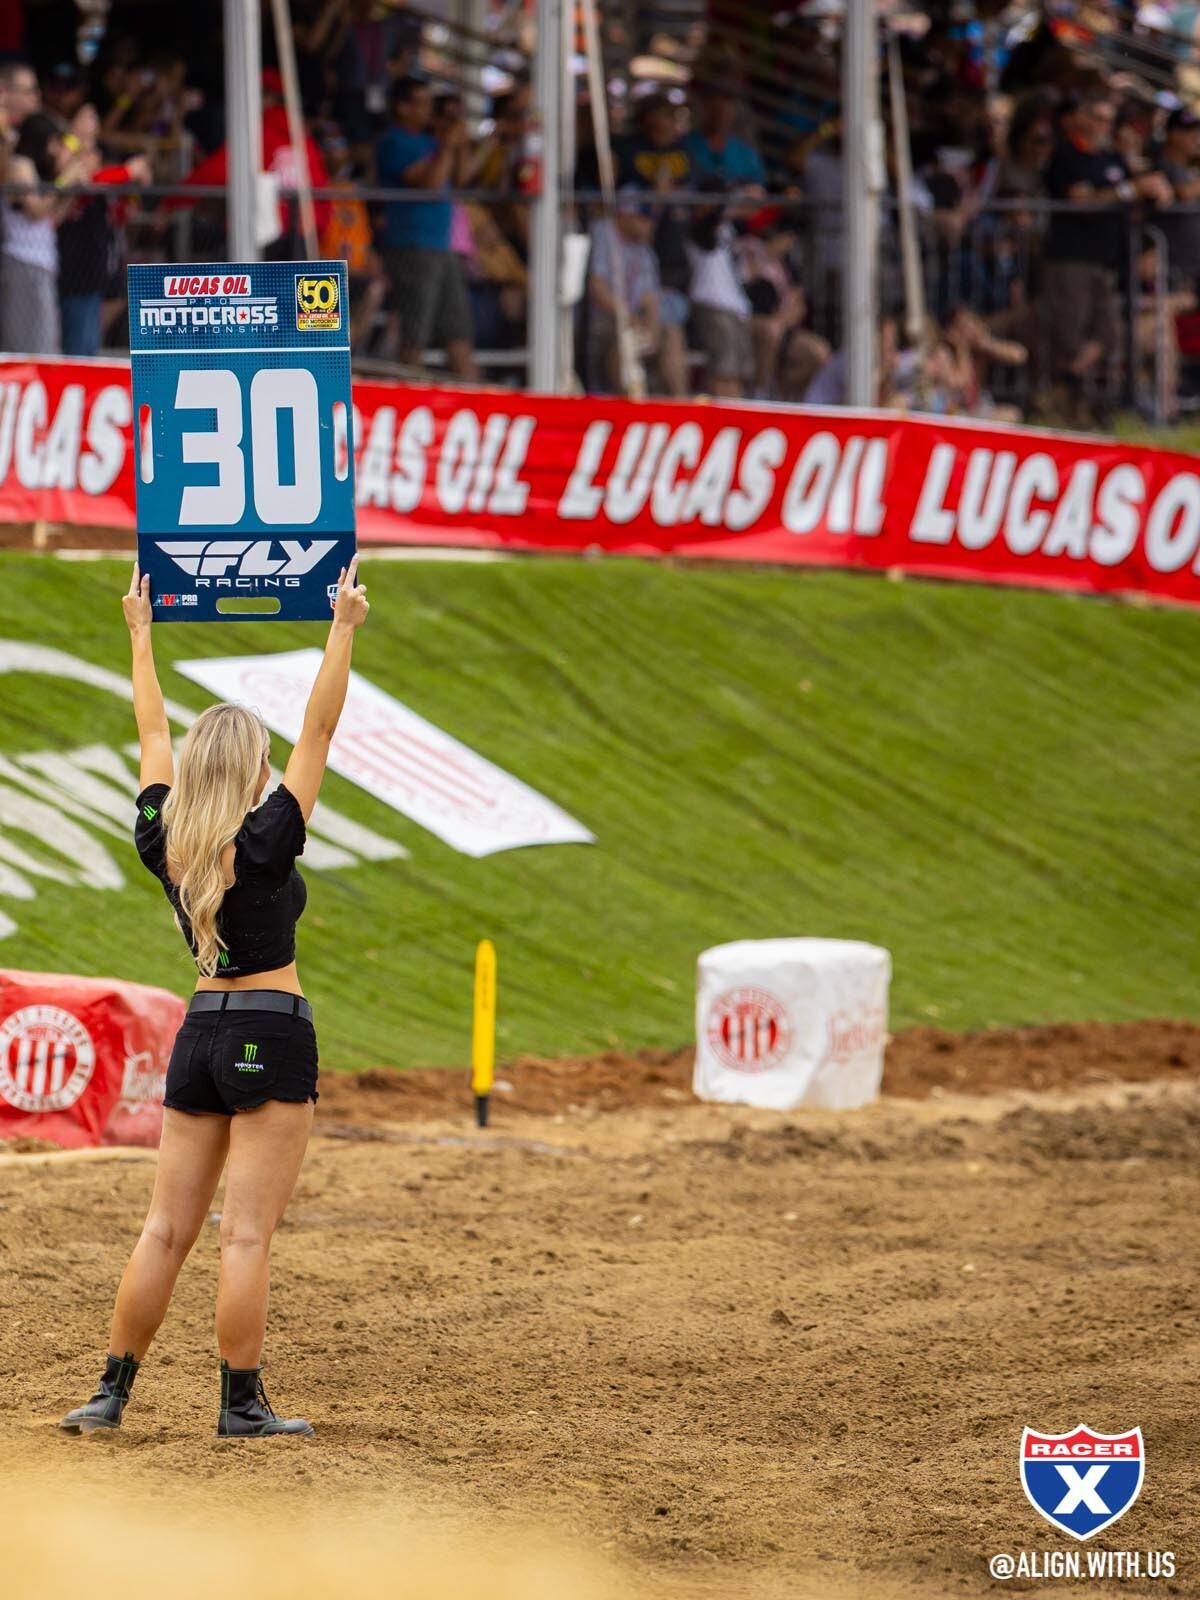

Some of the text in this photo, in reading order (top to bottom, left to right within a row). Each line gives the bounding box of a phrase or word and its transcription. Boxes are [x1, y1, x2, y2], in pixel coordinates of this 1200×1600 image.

[168, 276, 248, 296] LUCAS OIL
[302, 280, 335, 310] 50
[189, 298, 228, 306] PRO
[140, 306, 279, 326] MOTOCROSS
[140, 325, 280, 335] CHAMPIONSHIP
[174, 368, 323, 526] 30
[435, 407, 538, 516] OIL
[557, 419, 788, 531] LUCAS
[781, 431, 889, 537] OIL
[908, 442, 1146, 566] LUCAS
[170, 540, 339, 576] FLY
[195, 578, 300, 588] RACING
[181, 594, 198, 602] PRO
